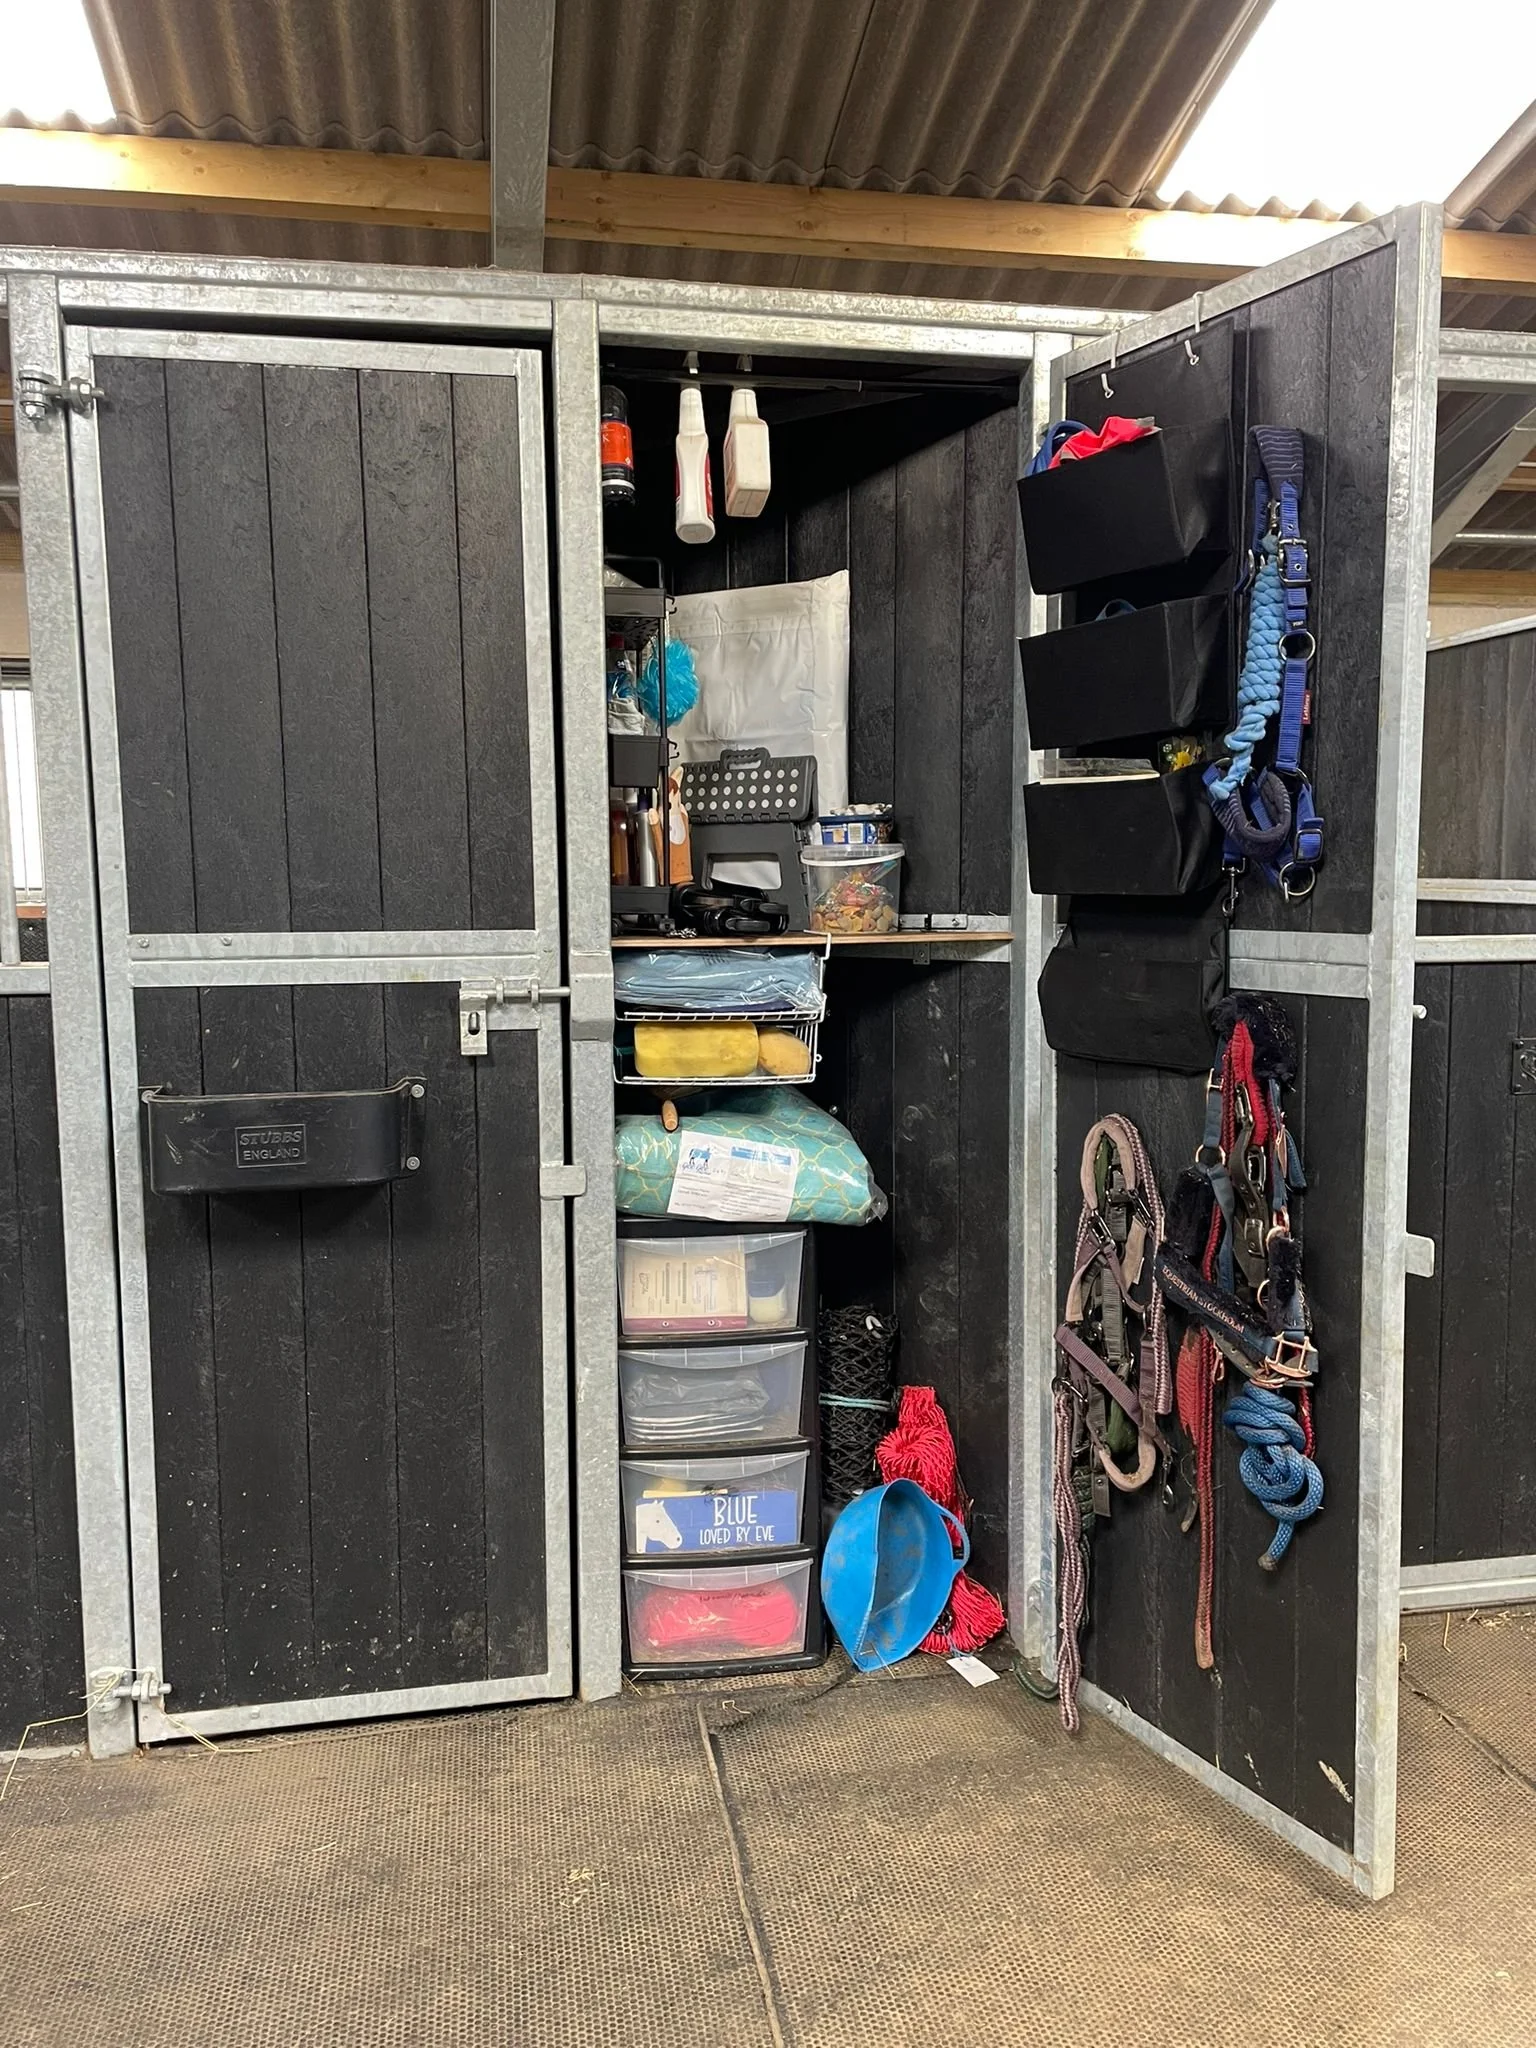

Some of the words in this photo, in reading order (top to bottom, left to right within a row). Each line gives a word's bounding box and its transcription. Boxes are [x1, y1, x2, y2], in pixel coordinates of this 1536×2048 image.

[239, 1130, 302, 1146] STUBBS
[243, 1147, 300, 1161] ENGLAND
[1162, 1265, 1199, 1302] EQUESTRIAN
[1198, 1298, 1244, 1333] STOCKHOLM
[713, 1495, 758, 1526] BLUE
[700, 1528, 731, 1545] LOVED
[736, 1526, 751, 1542] BY
[755, 1525, 775, 1542] EVE
